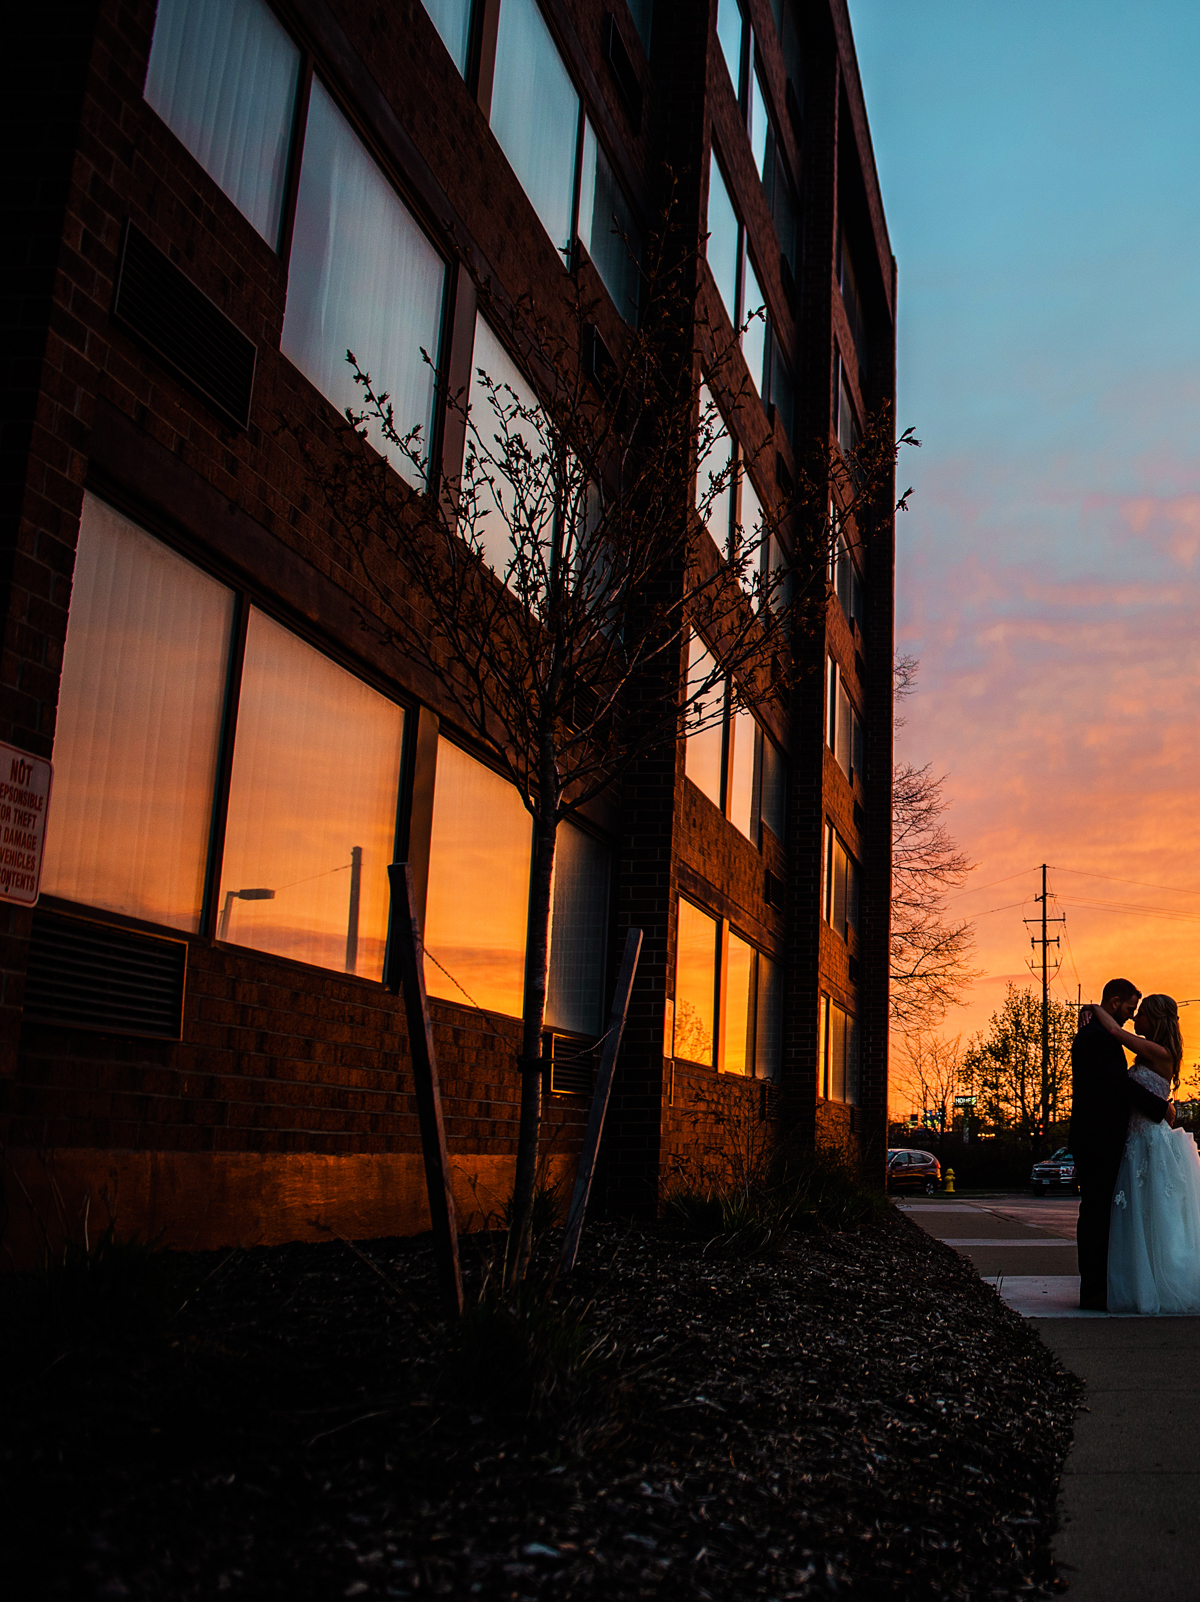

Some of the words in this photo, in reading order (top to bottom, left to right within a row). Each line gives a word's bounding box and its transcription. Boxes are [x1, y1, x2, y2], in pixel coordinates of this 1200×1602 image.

[10, 759, 33, 786] NOT
[13, 808, 37, 830] THEFT
[3, 827, 37, 851] DAMAGE
[0, 846, 36, 872] VEHICLES
[0, 867, 35, 891] ONTENTS
